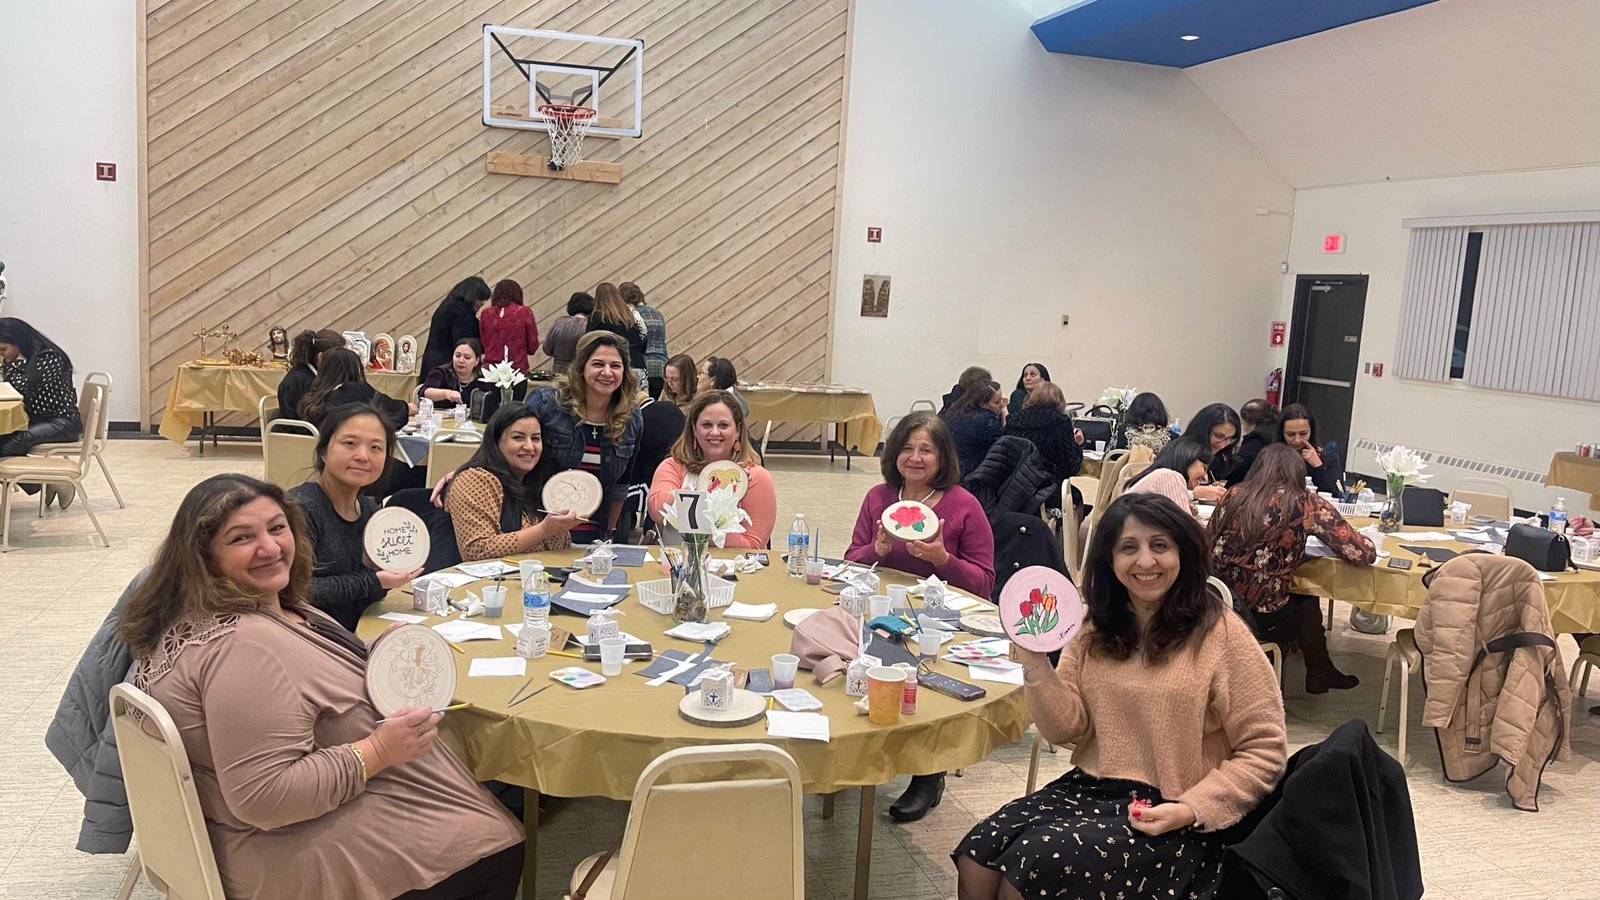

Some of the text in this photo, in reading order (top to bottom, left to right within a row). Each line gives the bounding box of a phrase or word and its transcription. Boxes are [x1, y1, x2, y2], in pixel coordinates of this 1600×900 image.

[678, 493, 700, 530] 7
[384, 526, 406, 535] HOME
[388, 547, 412, 557] HOME
